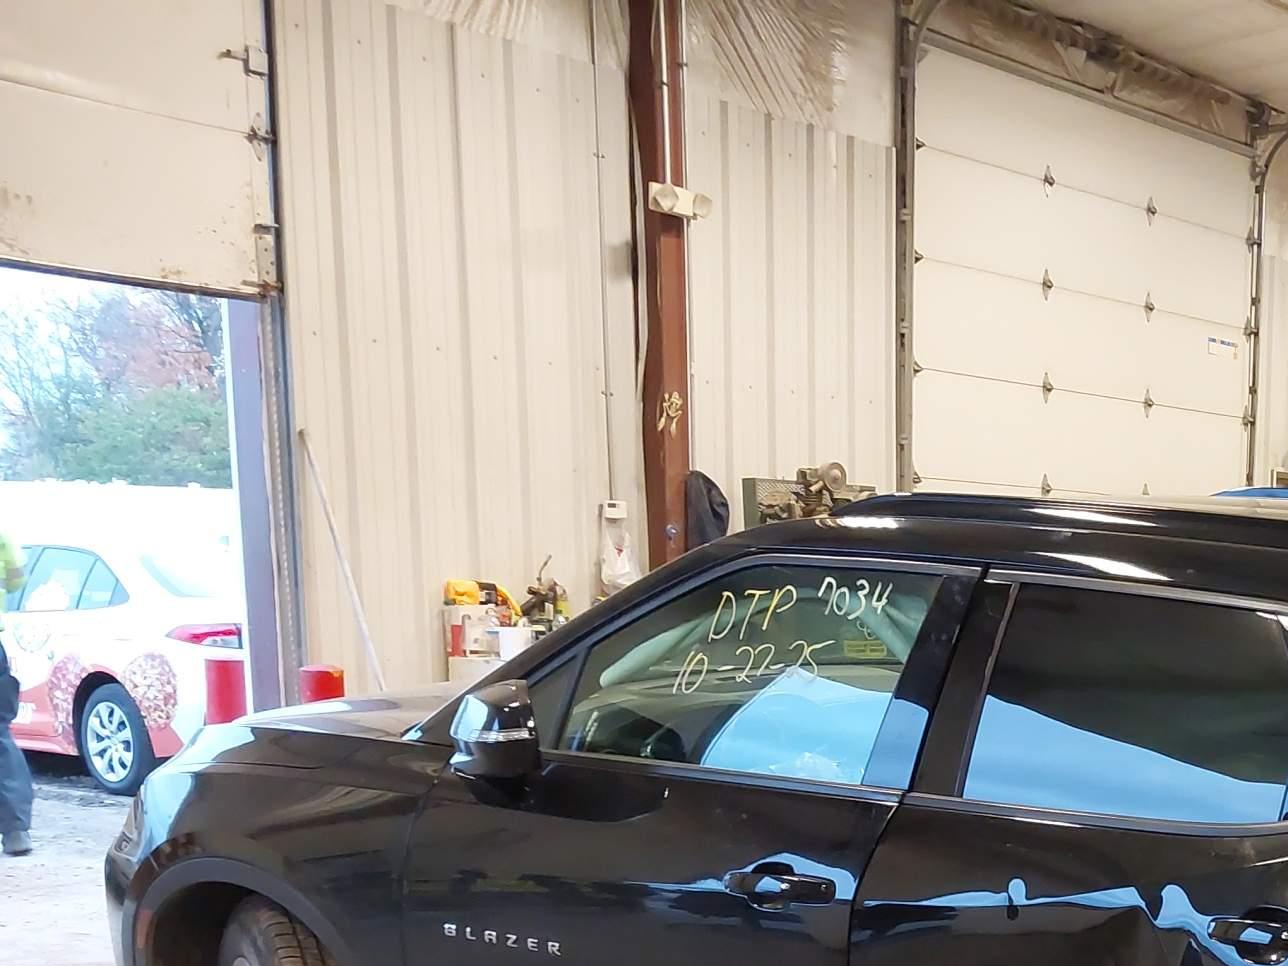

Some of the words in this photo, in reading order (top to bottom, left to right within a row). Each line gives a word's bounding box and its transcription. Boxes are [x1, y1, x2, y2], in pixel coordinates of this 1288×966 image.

[708, 585, 798, 643] DTP
[817, 576, 893, 620] 7034
[443, 922, 561, 956] BLAZER
